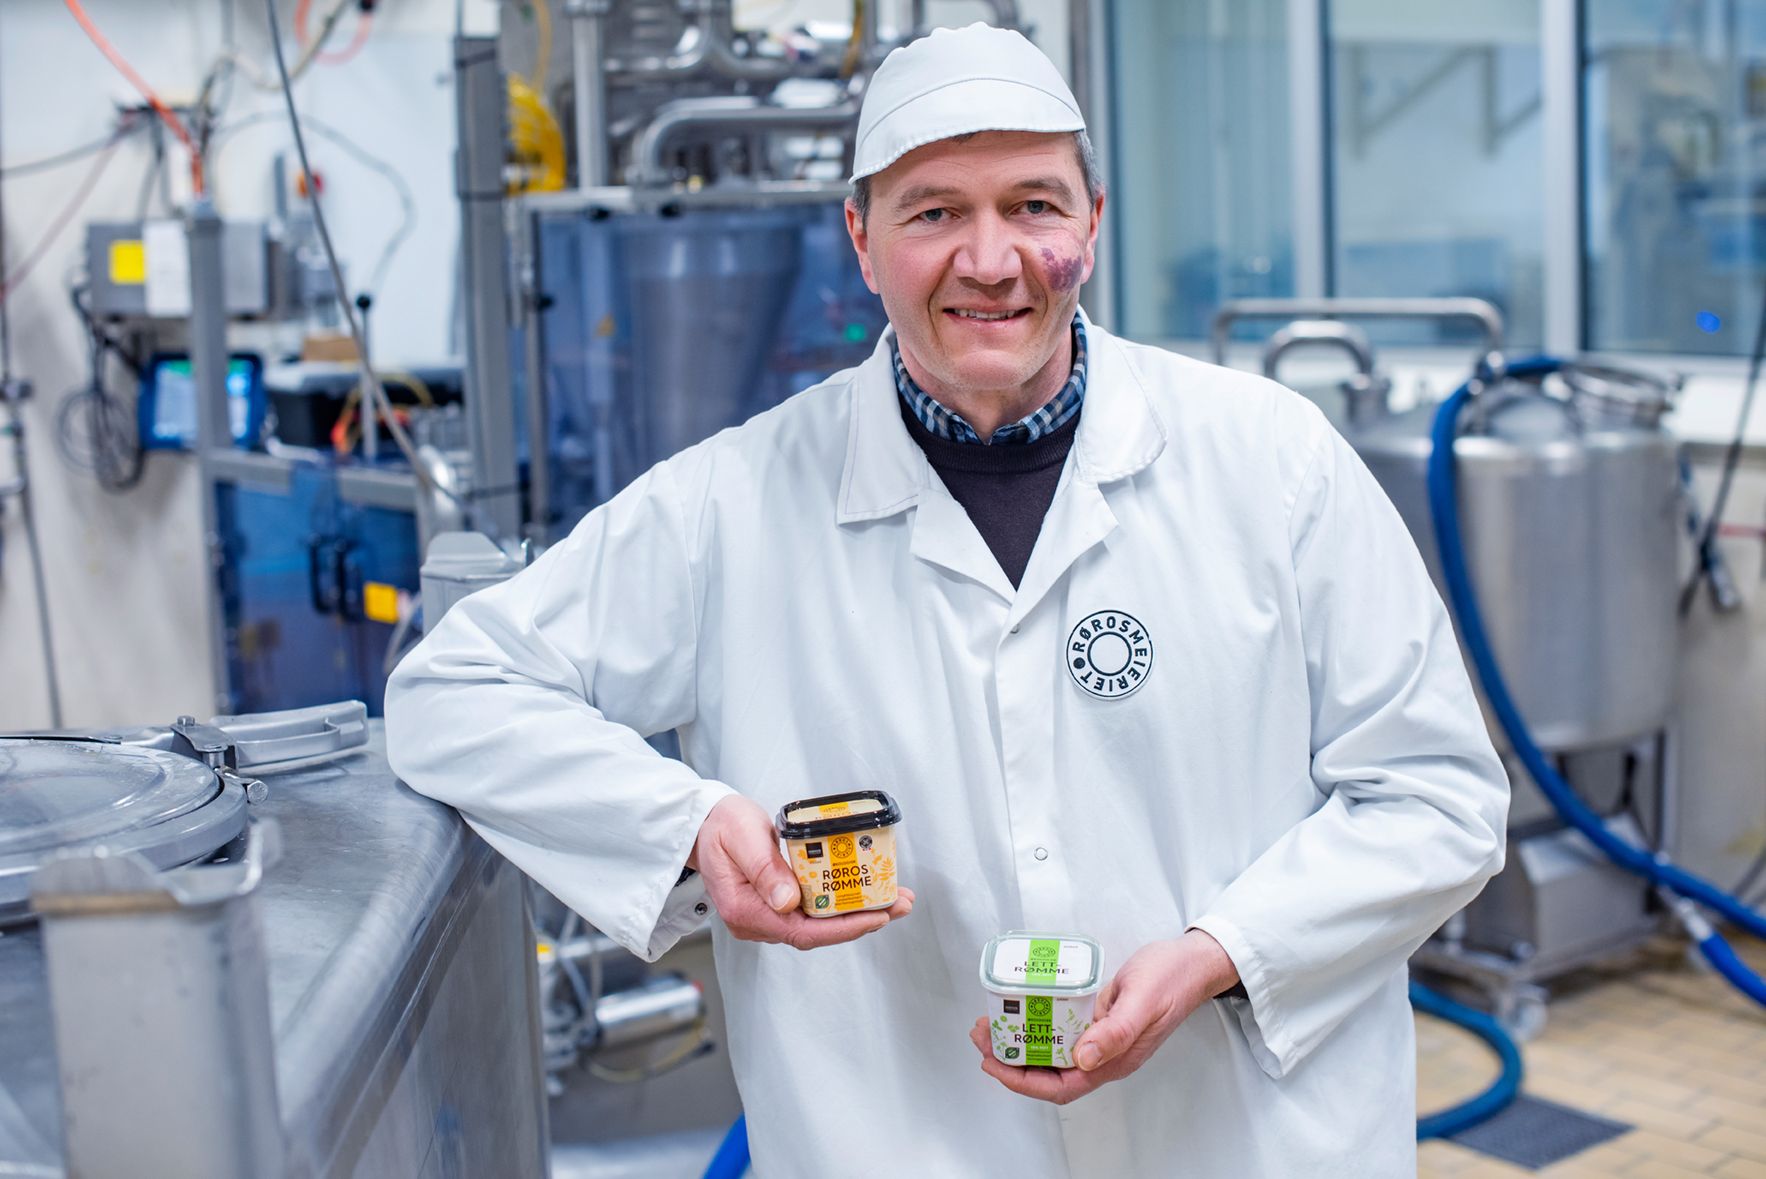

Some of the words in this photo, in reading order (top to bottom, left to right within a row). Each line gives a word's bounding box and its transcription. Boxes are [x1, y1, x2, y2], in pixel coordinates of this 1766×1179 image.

[1072, 616, 1147, 692] RØROSMEIERIET
[822, 864, 869, 880] RØROS
[822, 876, 872, 892] RØMME
[1014, 966, 1070, 974] RØMME
[1022, 1023, 1056, 1033] LETT-
[1014, 1034, 1064, 1044] RØMME
